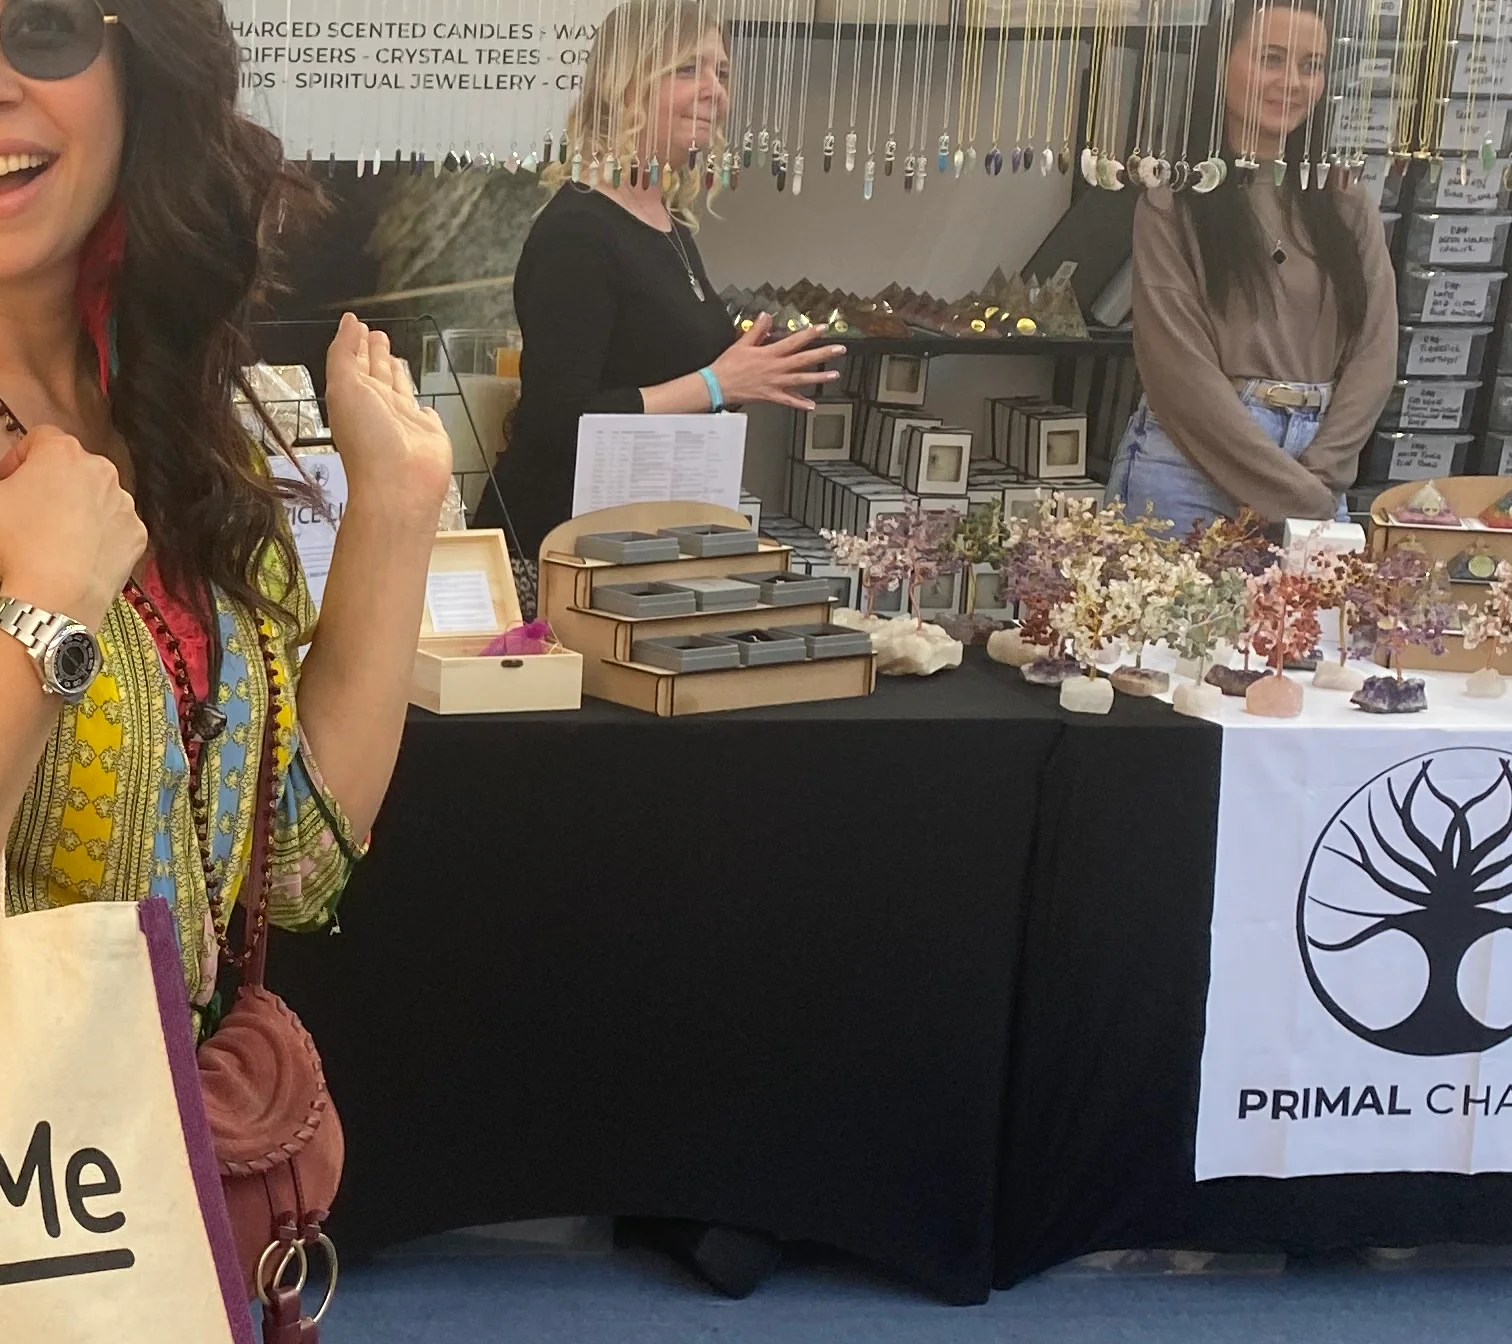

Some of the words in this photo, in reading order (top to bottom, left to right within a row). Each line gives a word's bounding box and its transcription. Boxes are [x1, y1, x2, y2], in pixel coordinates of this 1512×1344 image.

[327, 22, 426, 39] SCENTED
[433, 23, 534, 40] CANDLES
[375, 47, 469, 65] CRYSTAL
[475, 48, 541, 65] TREES
[295, 72, 403, 89] SPIRITUAL
[410, 73, 536, 90] JEWELLERY
[1238, 1084, 1411, 1121] PRIMAL
